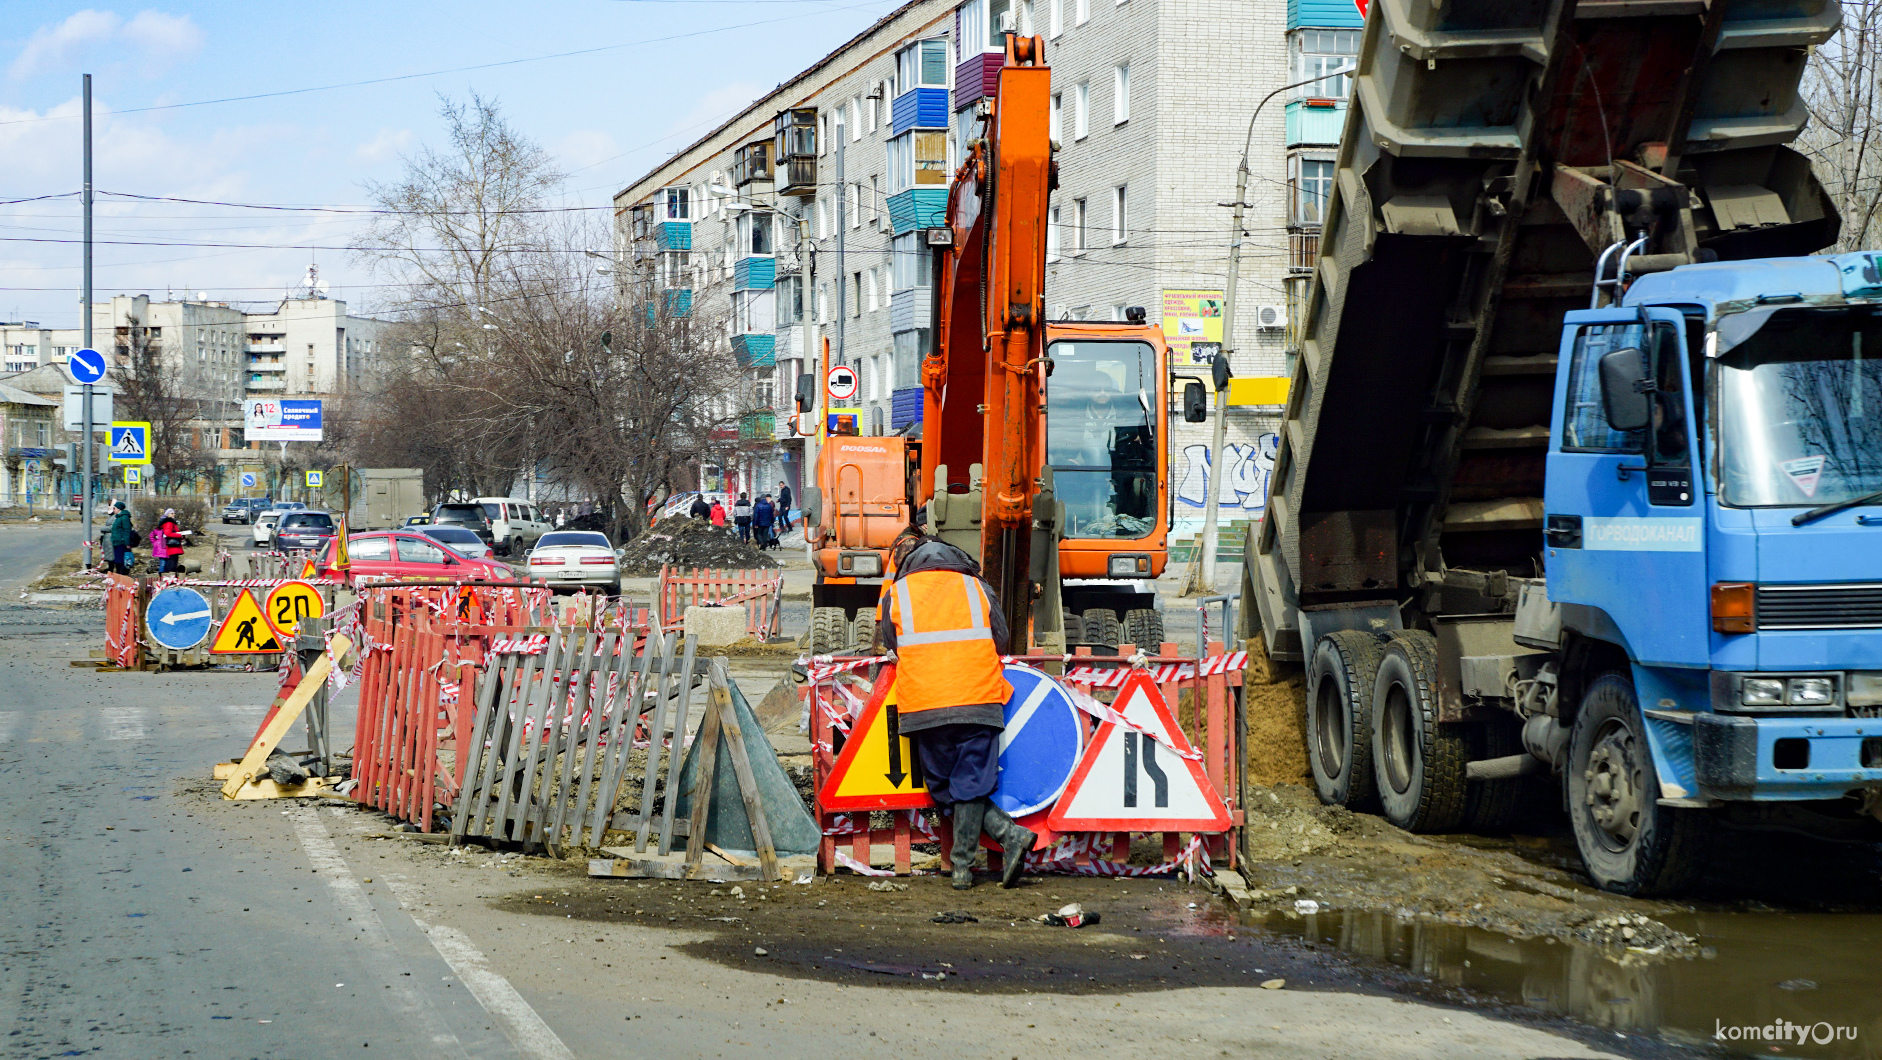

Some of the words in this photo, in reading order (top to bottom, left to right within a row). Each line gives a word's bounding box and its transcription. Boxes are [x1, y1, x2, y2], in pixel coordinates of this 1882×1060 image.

[841, 445, 887, 453] DOOSAN
[1590, 525, 1696, 545] ГОРВОДОКАНАЛ
[276, 595, 310, 624] 20
